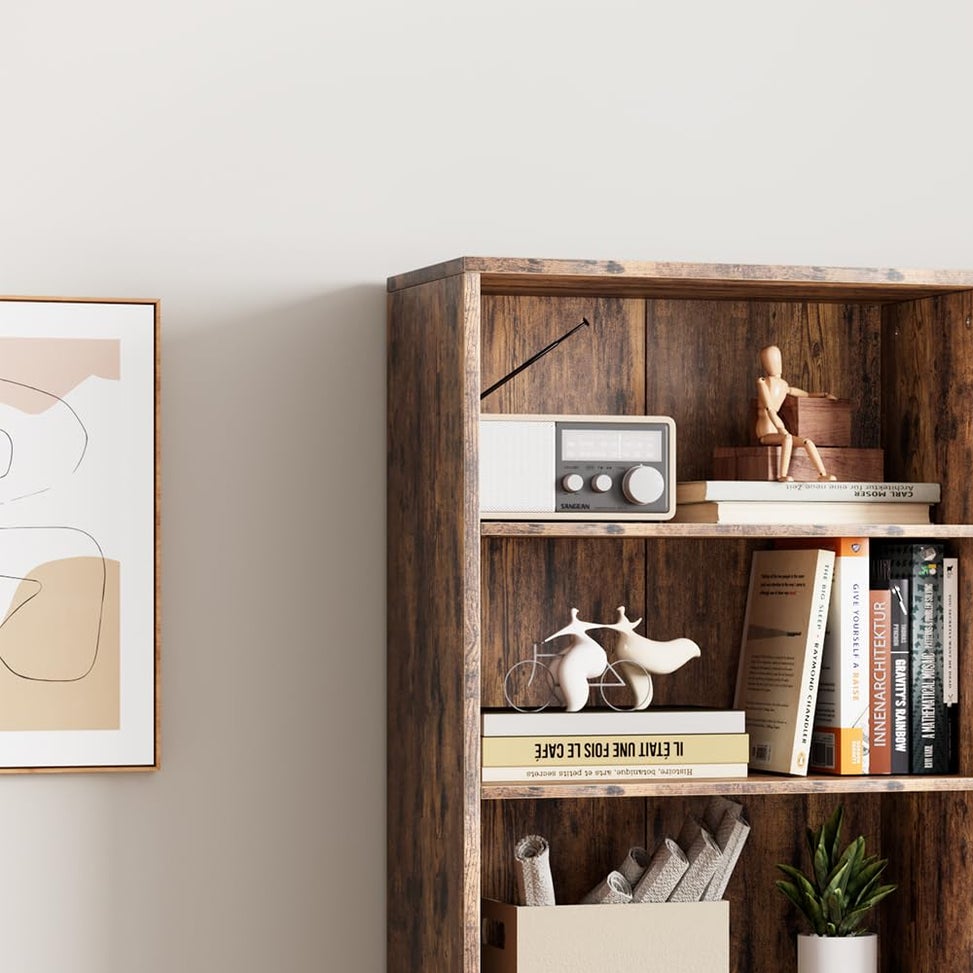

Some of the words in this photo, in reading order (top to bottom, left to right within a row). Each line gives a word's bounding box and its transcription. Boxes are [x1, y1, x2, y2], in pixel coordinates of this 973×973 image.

[822, 564, 830, 582] THE
[820, 584, 828, 600] BIG
[852, 583, 860, 606] GIVE
[816, 603, 824, 630] SLEEP
[852, 609, 860, 658] YOURSELF
[807, 641, 820, 692] RAYMOND
[874, 601, 886, 748] INNENARCHITEKTUR
[921, 652, 936, 679] MOSAIC
[852, 672, 860, 702] RAISE
[894, 658, 906, 706] GRAVITY'S
[921, 680, 936, 732] MATHEMATICAL
[801, 694, 813, 744] CHANDLER
[894, 708, 906, 752] RAINBOW
[534, 744, 564, 762] CAFÉ
[567, 743, 581, 758] LE
[584, 743, 610, 758] FOIS
[612, 742, 636, 758] UNE
[639, 742, 670, 760] ÉTAIT
[673, 742, 684, 757] IL
[526, 770, 557, 778] secrets
[558, 769, 583, 778] petits
[614, 768, 656, 777] botanique,
[658, 768, 693, 776] Histoire,
